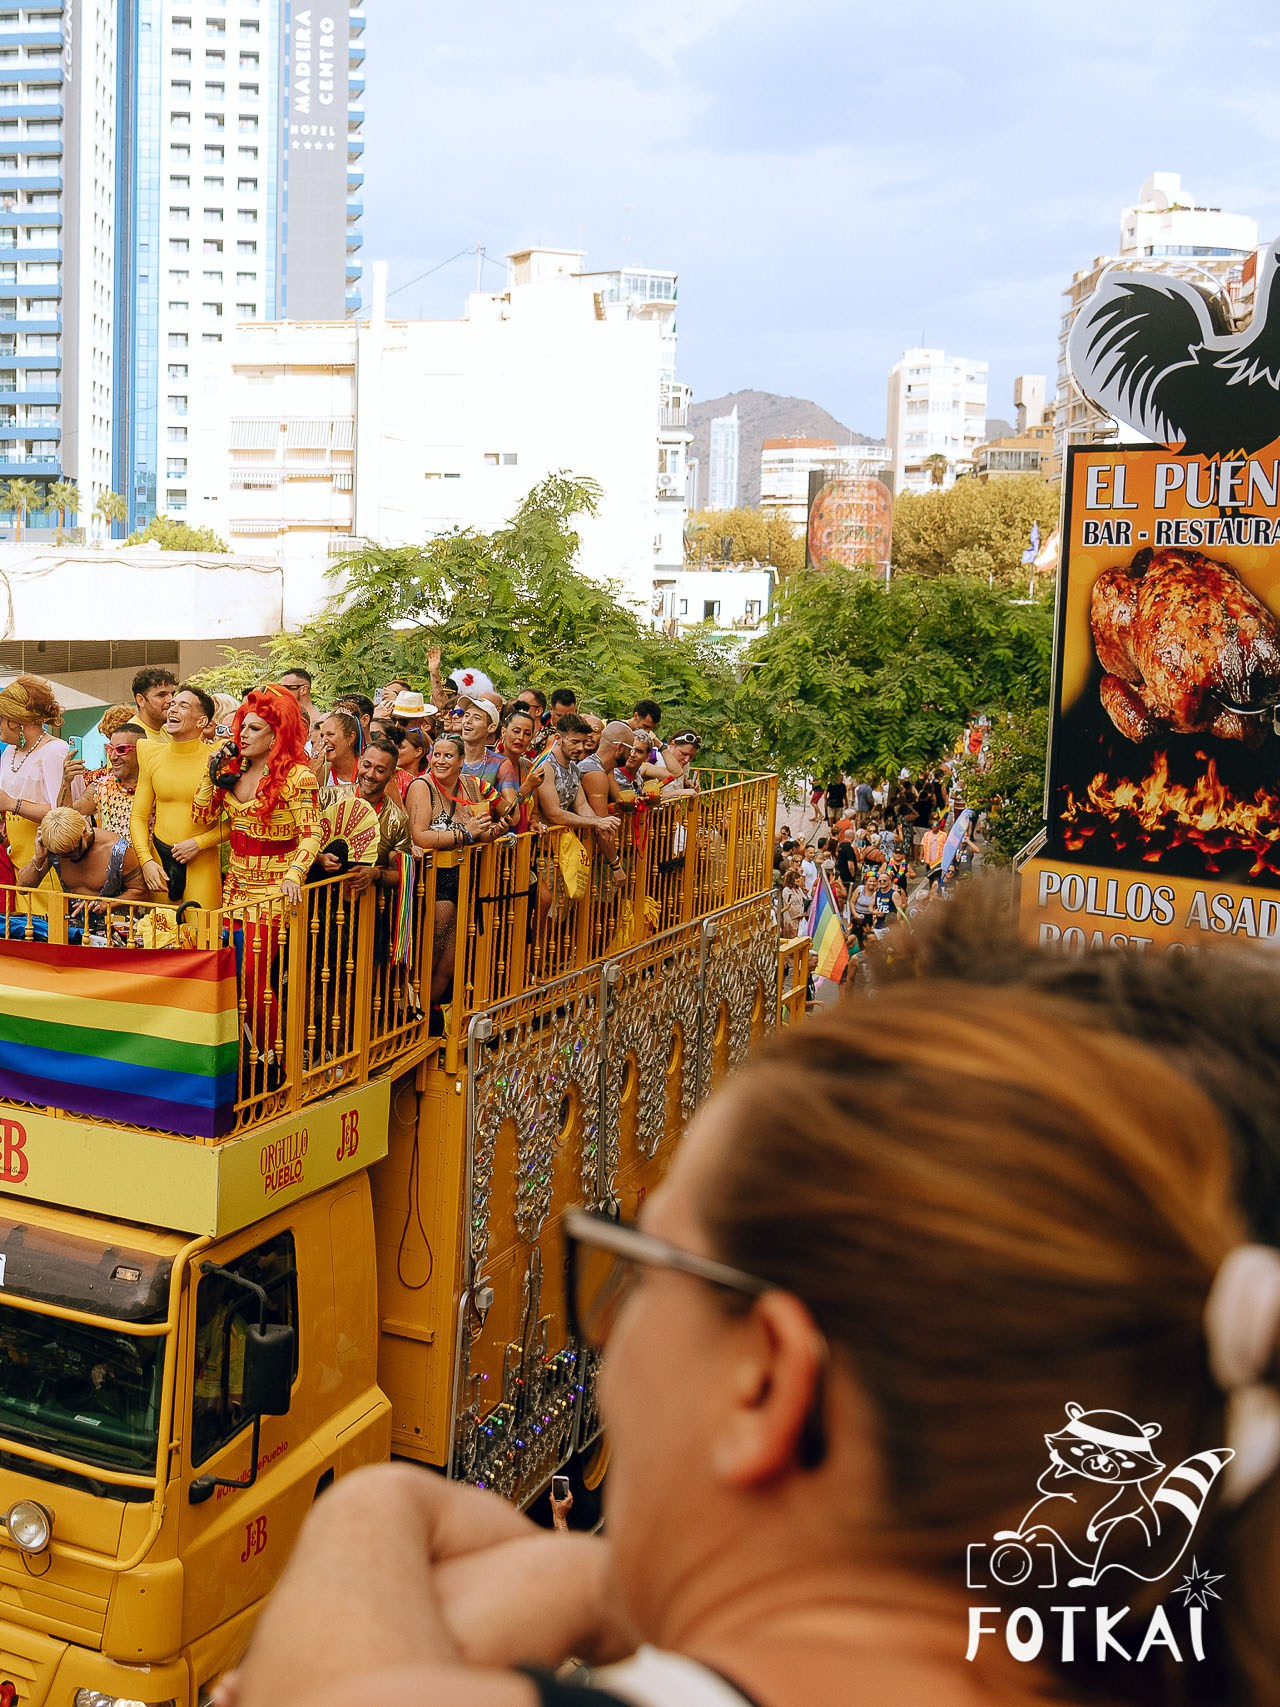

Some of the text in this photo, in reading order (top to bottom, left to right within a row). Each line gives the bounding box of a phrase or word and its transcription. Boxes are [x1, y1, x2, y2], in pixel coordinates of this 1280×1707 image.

[294, 10, 311, 114] MADEIRA
[319, 17, 335, 105] CENTRO
[290, 124, 336, 136] HOTEL
[1085, 459, 1280, 510] EL PUEN
[1083, 519, 1132, 546] BAR
[1038, 870, 1280, 939] POLLOS ASAD
[260, 1128, 309, 1176] ORGULLO
[336, 1109, 360, 1162] J&B
[264, 1159, 303, 1195] PUEBLO
[241, 1515, 267, 1562] J&B
